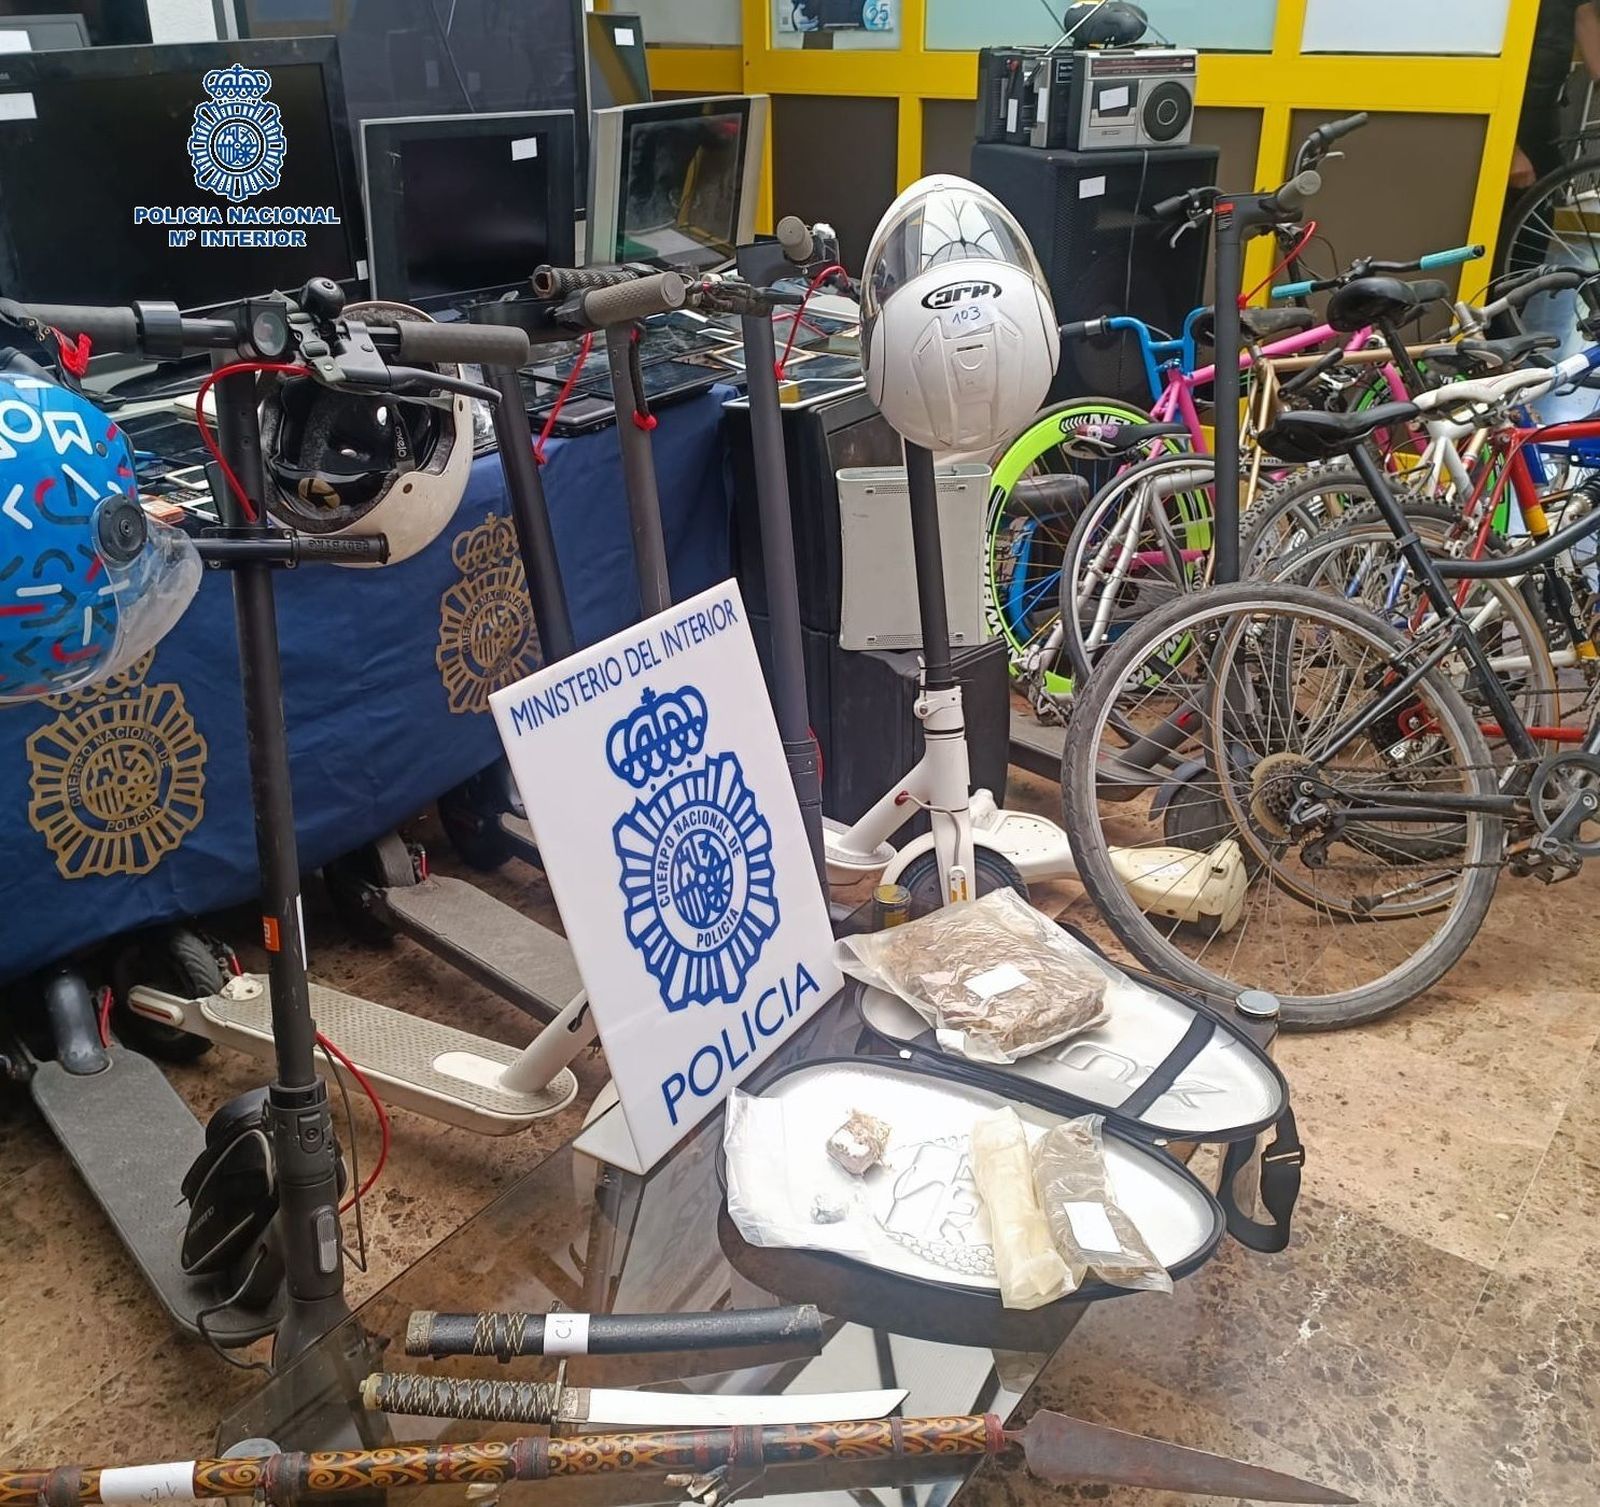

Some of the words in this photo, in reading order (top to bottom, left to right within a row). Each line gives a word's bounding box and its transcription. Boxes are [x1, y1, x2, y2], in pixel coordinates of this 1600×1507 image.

[868, 3, 889, 26] 25
[952, 305, 981, 325] 103
[509, 656, 623, 737] MINISTERIO
[623, 638, 662, 677] DEL
[660, 598, 739, 659] INTERIOR
[68, 744, 93, 807] CUERPO
[93, 726, 161, 751] NACIONAL
[157, 749, 171, 769] DE
[104, 803, 162, 832] POLICIA
[656, 835, 676, 909] CUERPO
[673, 809, 730, 839] NACIONAL
[728, 836, 743, 859] DE
[696, 907, 740, 948] POLICIA
[661, 962, 821, 1126] POLICIA
